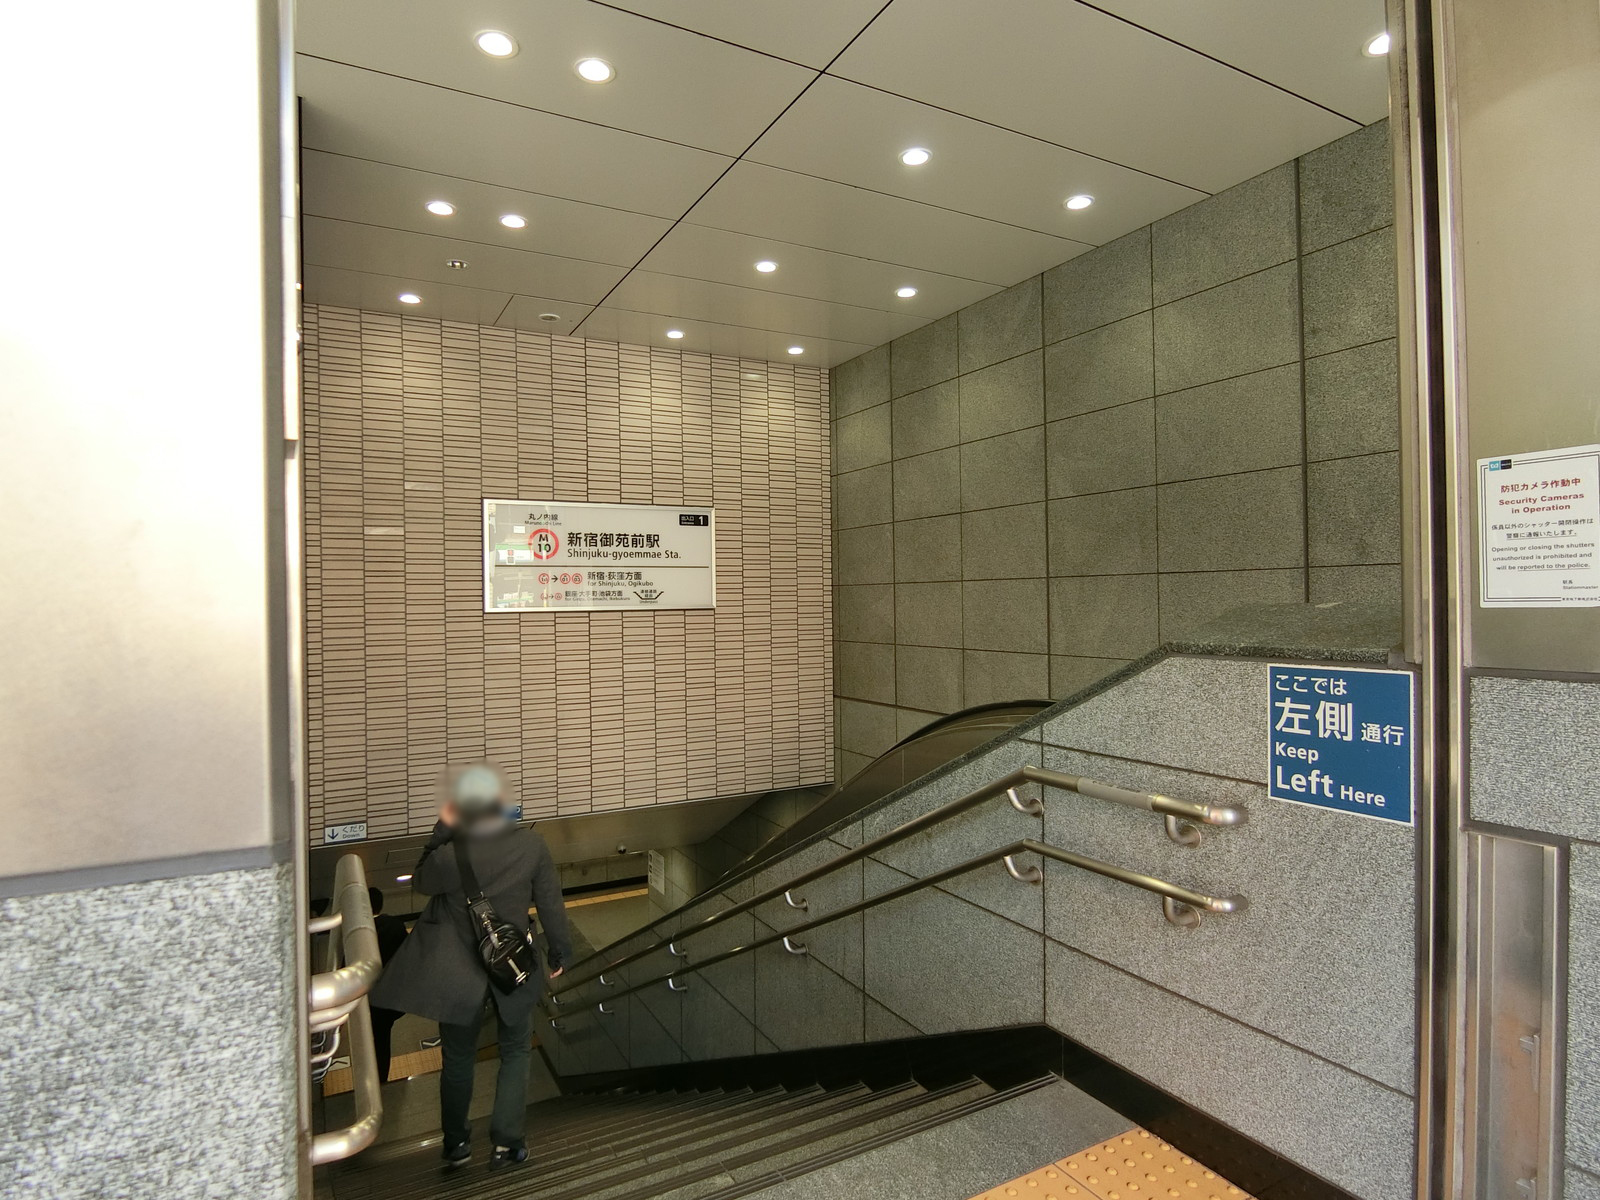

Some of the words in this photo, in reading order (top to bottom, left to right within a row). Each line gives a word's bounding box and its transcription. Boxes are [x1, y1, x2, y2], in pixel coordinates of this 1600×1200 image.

[1500, 477, 1581, 494] 防犯カメラ作動中
[1498, 496, 1538, 506] Security
[1540, 492, 1585, 502] Cameras
[1522, 503, 1571, 514] Operation
[698, 515, 704, 526] 1
[538, 533, 549, 543] M
[567, 531, 660, 548] 新宿御苑前駅
[537, 543, 552, 553] 10
[1491, 545, 1518, 553] Opening
[1527, 544, 1553, 552] closing
[567, 548, 662, 561] Shinjuku-gyoemmae
[664, 549, 682, 559] Sta.
[1492, 554, 1534, 562] unauthorized
[1542, 552, 1578, 560] prohibited
[1517, 563, 1545, 571] reported
[627, 580, 654, 588] Ogikubo
[1275, 674, 1348, 696] ここでは
[1274, 696, 1353, 742] 左側
[1360, 722, 1405, 746] 通行
[1275, 741, 1319, 764] Keep
[1276, 765, 1334, 798] Left
[1340, 785, 1386, 807] Here
[342, 824, 365, 833] くだり
